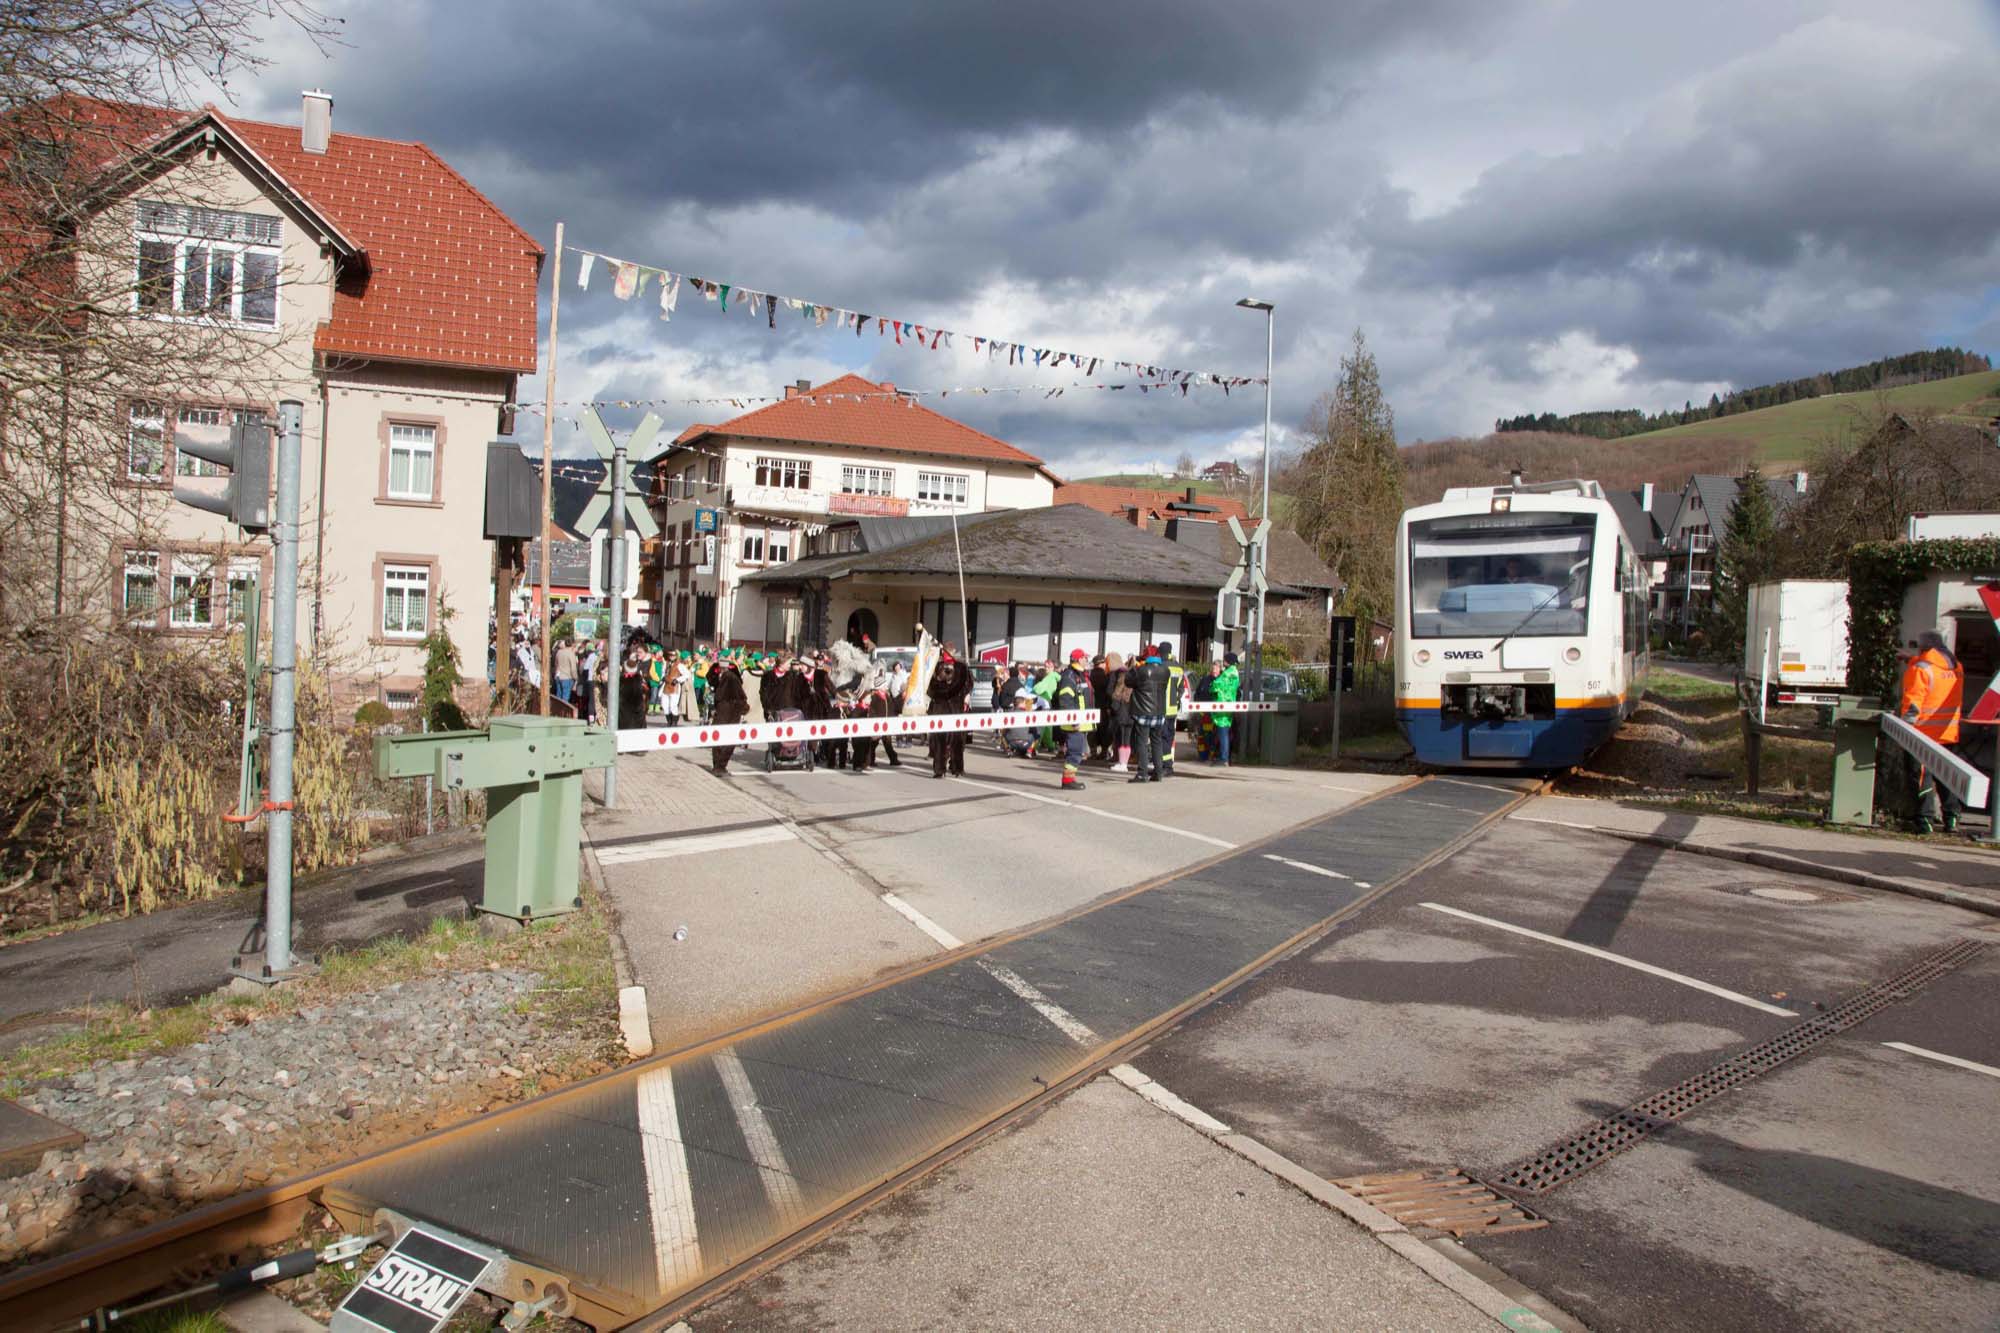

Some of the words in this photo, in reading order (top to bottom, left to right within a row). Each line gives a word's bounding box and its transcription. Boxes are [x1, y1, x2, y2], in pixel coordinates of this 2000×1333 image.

[1443, 650, 1484, 660] SWEG
[1588, 680, 1601, 690] 507
[367, 1256, 461, 1316] STRAIL
